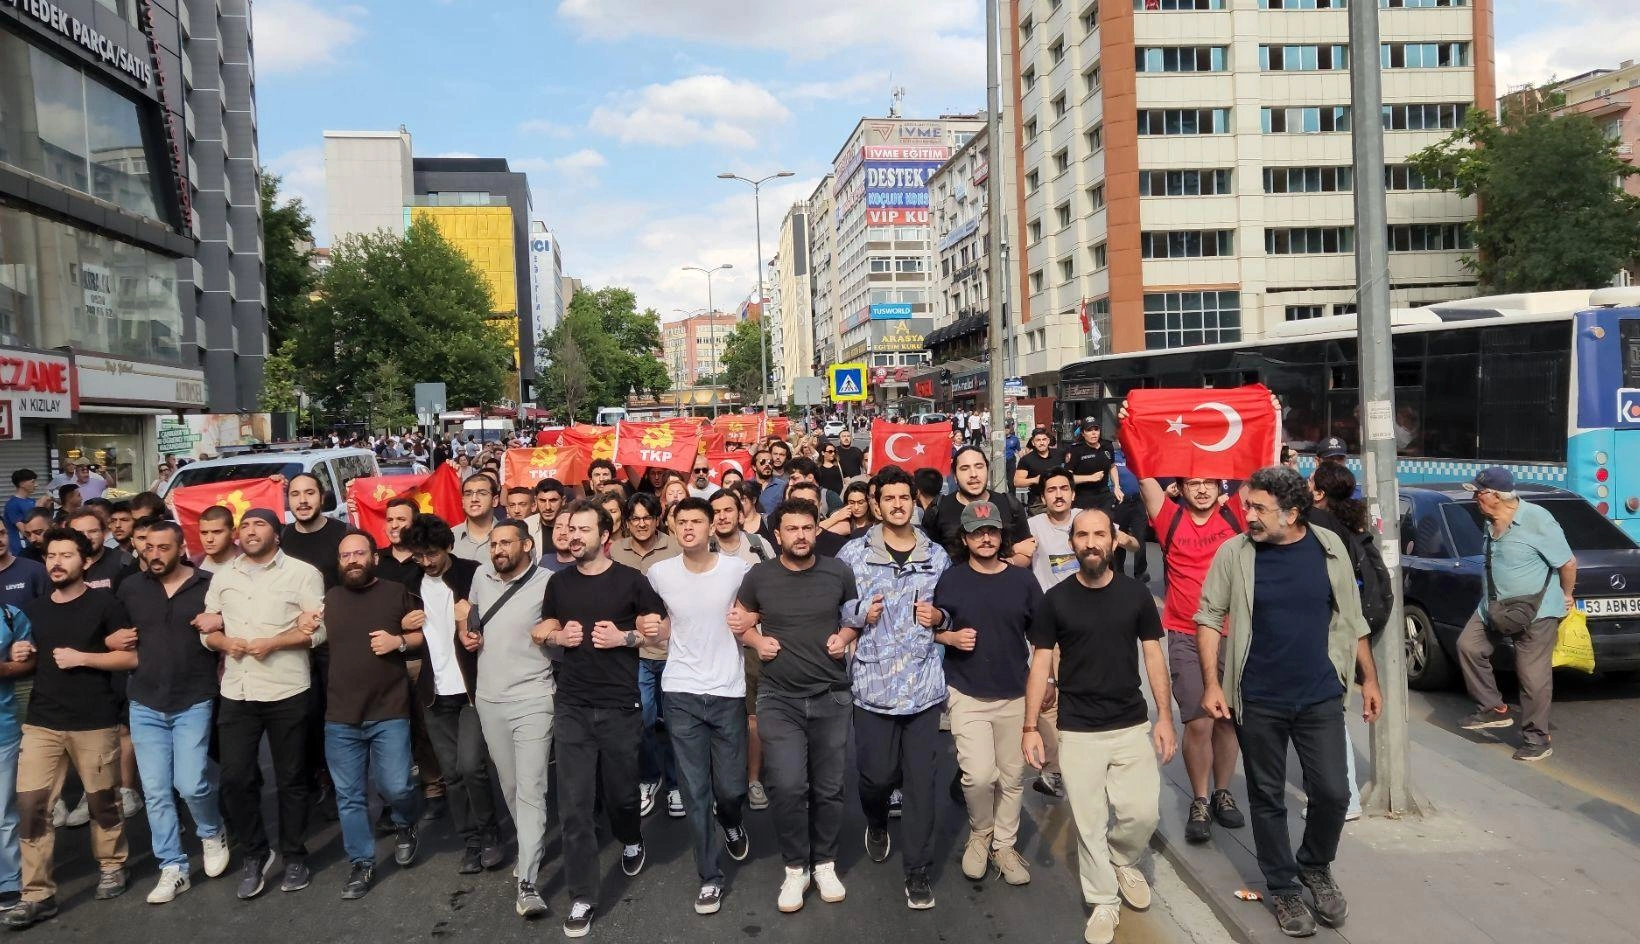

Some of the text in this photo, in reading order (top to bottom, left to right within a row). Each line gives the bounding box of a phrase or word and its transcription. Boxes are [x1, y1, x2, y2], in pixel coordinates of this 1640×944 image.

[868, 168, 924, 188] DESTEK
[30, 399, 61, 412] KIZILAY
[640, 449, 673, 463] TKP
[529, 469, 557, 479] TKP
[974, 503, 992, 519] W
[1585, 601, 1601, 613] 53
[1606, 600, 1628, 612] ABN
